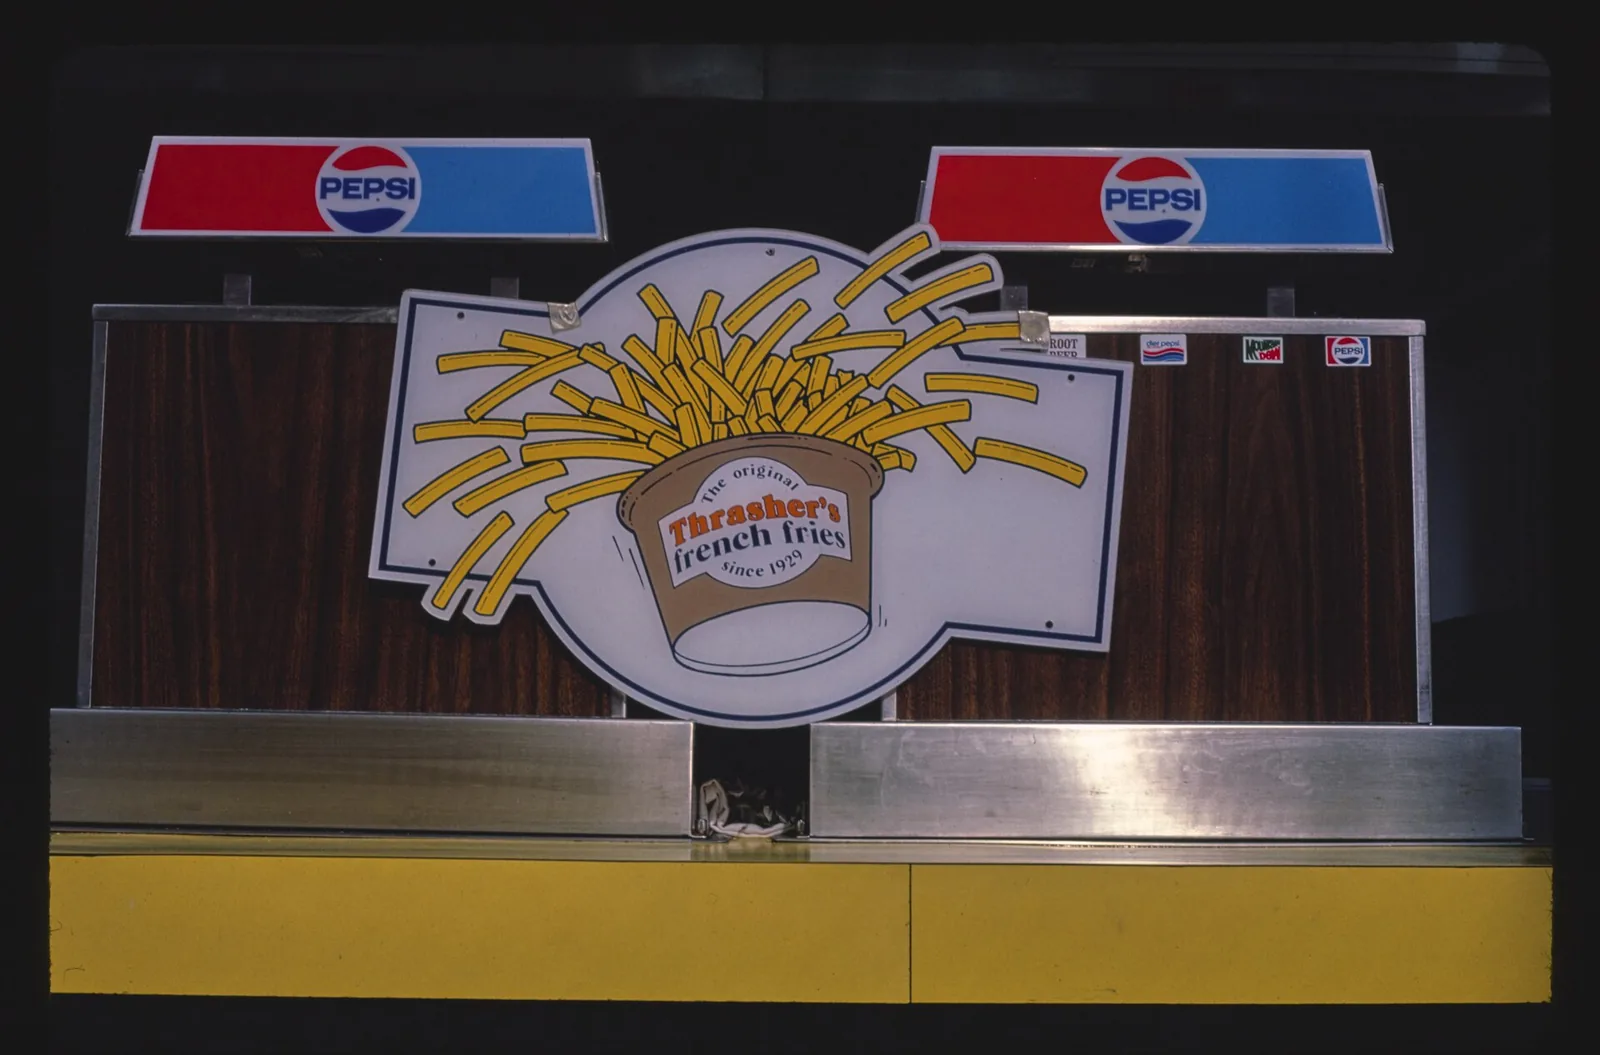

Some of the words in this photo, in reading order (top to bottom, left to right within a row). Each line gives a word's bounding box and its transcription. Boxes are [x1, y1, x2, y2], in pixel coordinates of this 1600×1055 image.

[320, 177, 416, 200] PEPSI
[1105, 188, 1201, 211] PEPSI
[1050, 338, 1078, 349] ROOT
[1334, 347, 1363, 355] PEPSI
[702, 478, 727, 504] The
[733, 464, 799, 491] original
[669, 494, 841, 547] Thrasher's
[674, 524, 772, 574] french
[782, 520, 846, 549] fries
[721, 561, 764, 577] since
[770, 549, 802, 575] 1929
